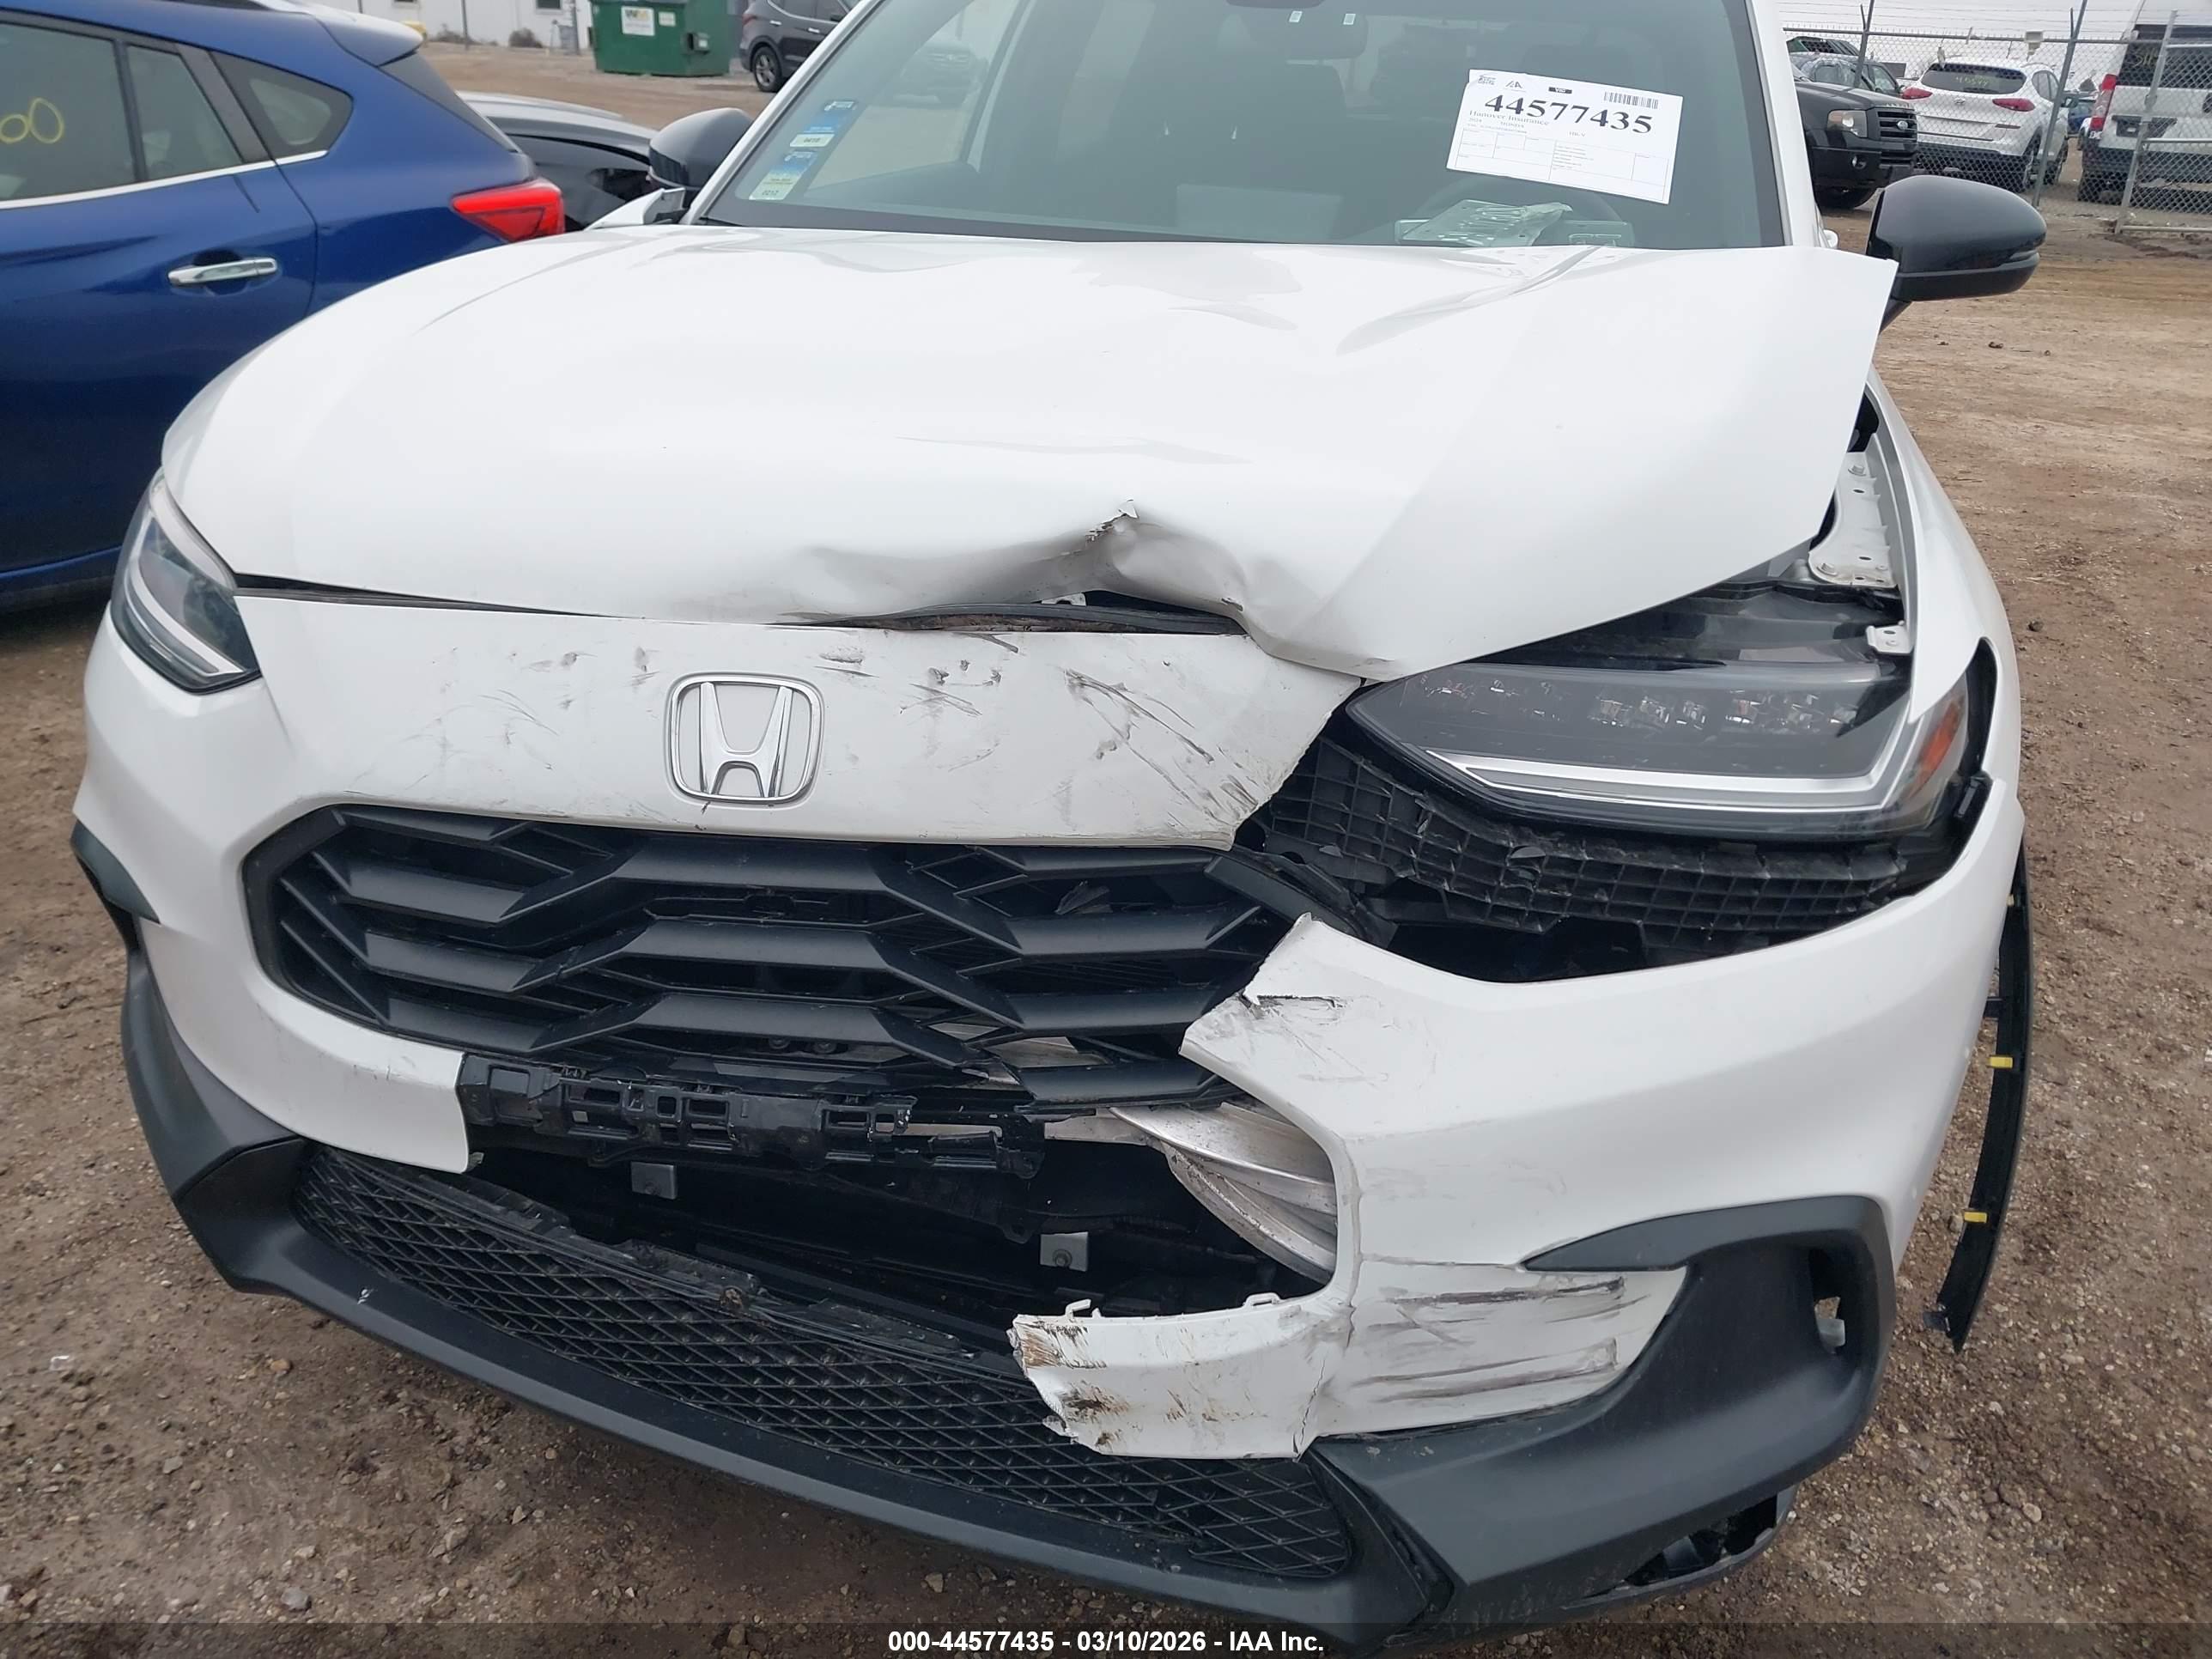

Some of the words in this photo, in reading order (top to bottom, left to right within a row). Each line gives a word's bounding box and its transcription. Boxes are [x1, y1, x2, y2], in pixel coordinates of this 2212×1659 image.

[1469, 110, 1506, 119] Hanover
[1508, 115, 1550, 126] Insurance
[1485, 94, 1653, 134] 44577435
